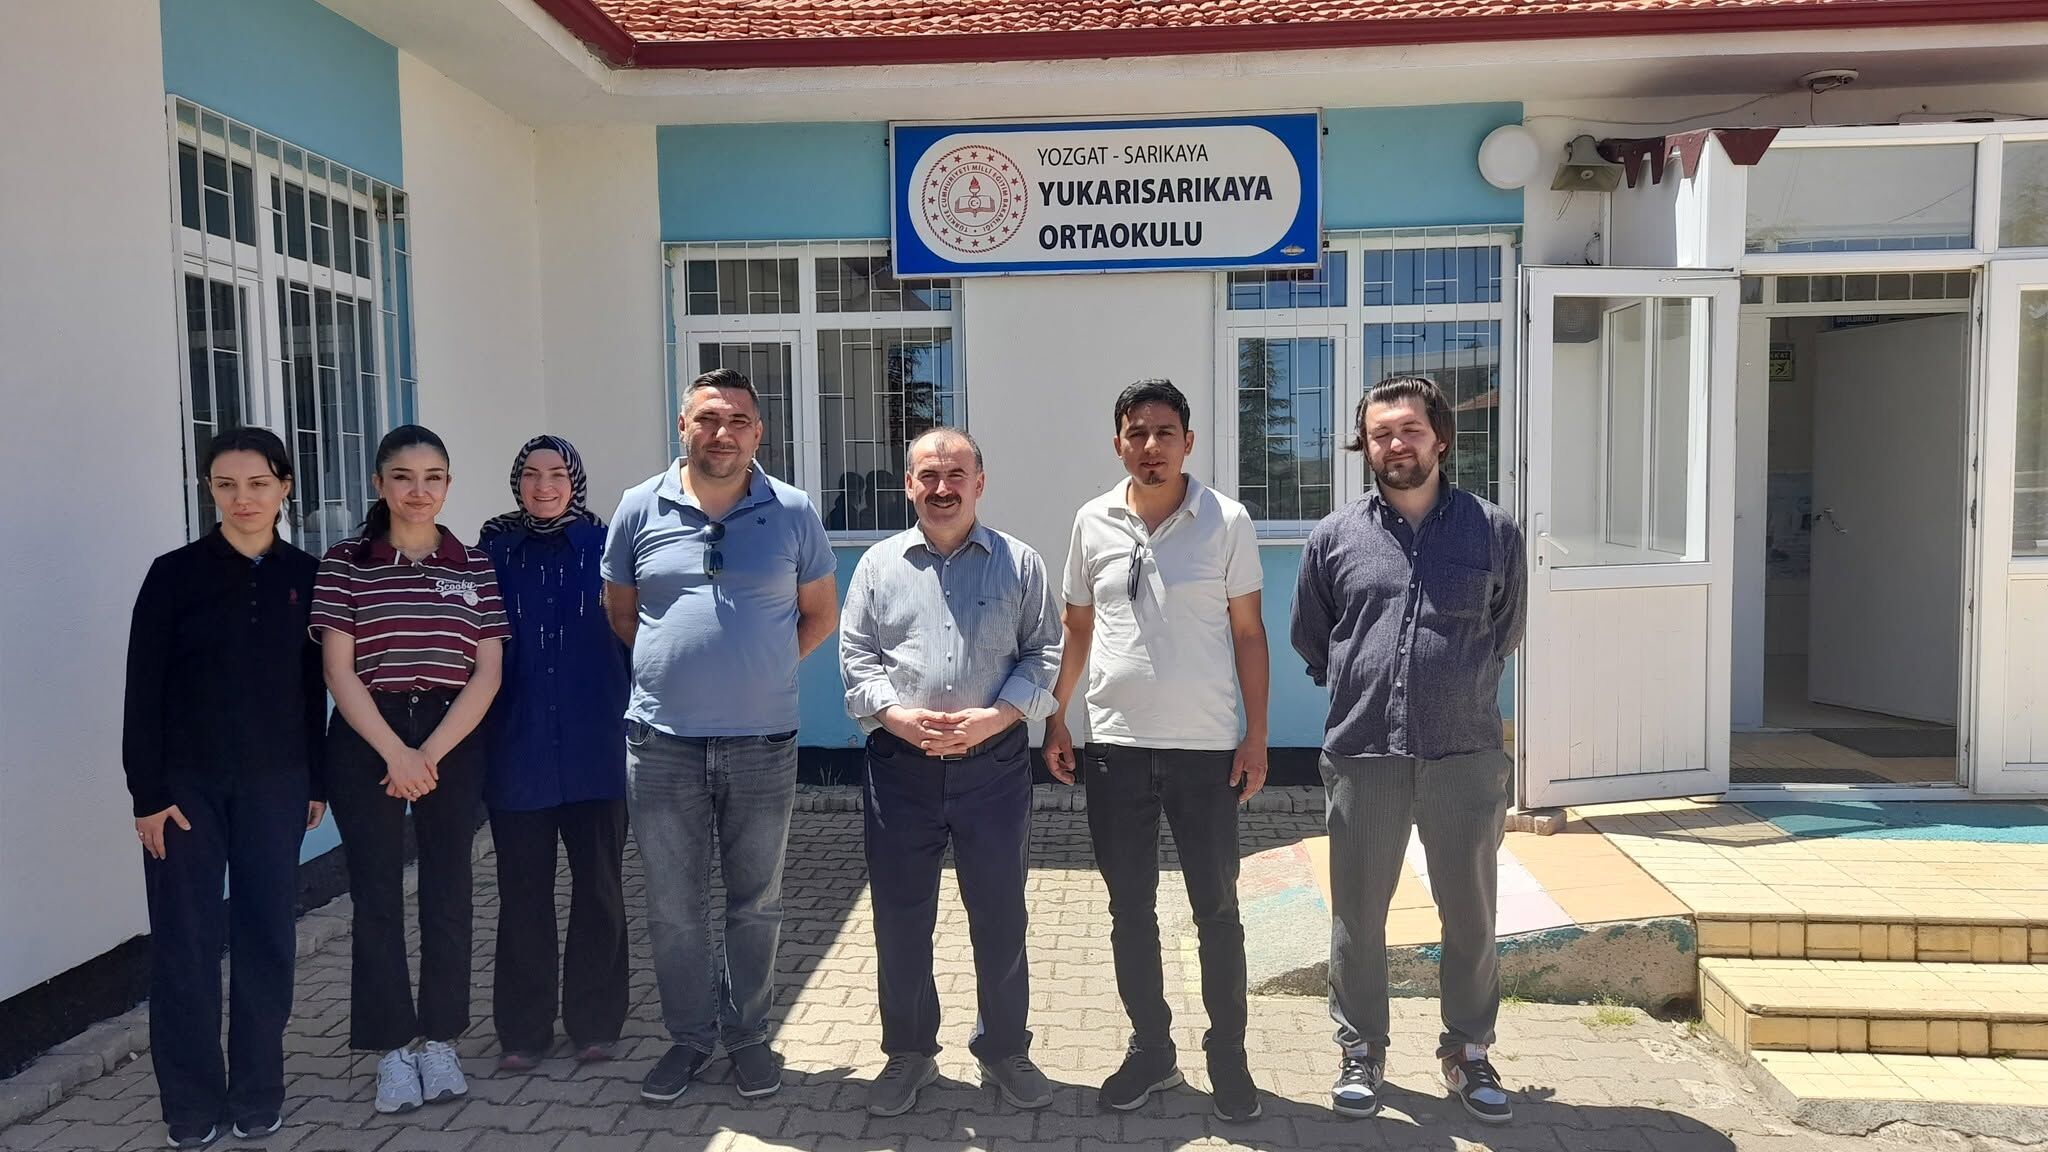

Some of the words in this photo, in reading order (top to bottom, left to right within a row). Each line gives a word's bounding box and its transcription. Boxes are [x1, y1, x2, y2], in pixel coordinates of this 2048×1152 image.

[1037, 146, 1108, 166] YOZGAT
[1124, 143, 1209, 165] SARIKAYA
[972, 164, 993, 175] MİLLİ
[941, 164, 970, 208] CUMHURİYETİ
[1038, 175, 1273, 207] YUKARISARIKAYA
[944, 209, 969, 233] TÜRKİYE
[982, 198, 1009, 233] BAKANLIĞI
[1038, 221, 1203, 250] ORTAOKULU
[435, 579, 477, 592] Scooby
